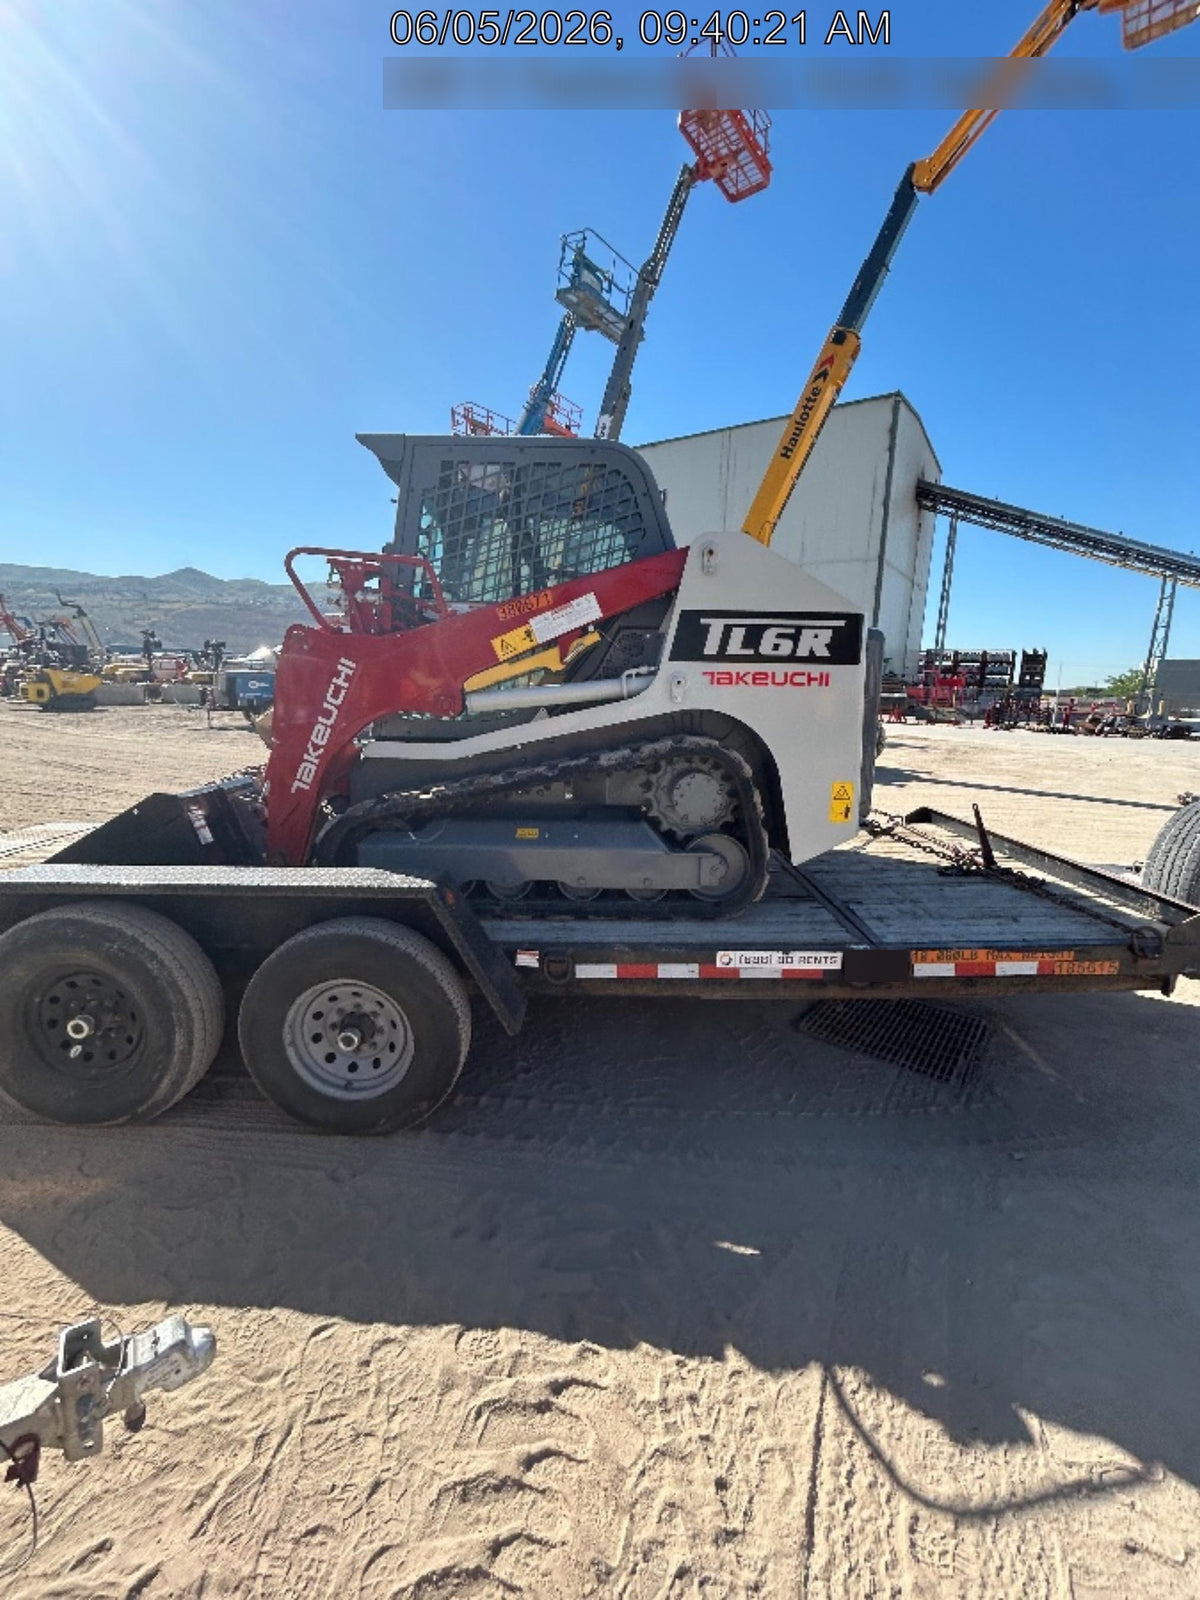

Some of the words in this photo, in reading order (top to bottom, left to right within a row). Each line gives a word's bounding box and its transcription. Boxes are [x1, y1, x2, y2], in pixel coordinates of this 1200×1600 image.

[780, 386, 821, 460] Haulotte
[700, 617, 847, 658] TL6R
[702, 671, 831, 688] TAKEUCHI
[291, 657, 356, 794] TAKEUCHI
[798, 955, 838, 966] RENTS
